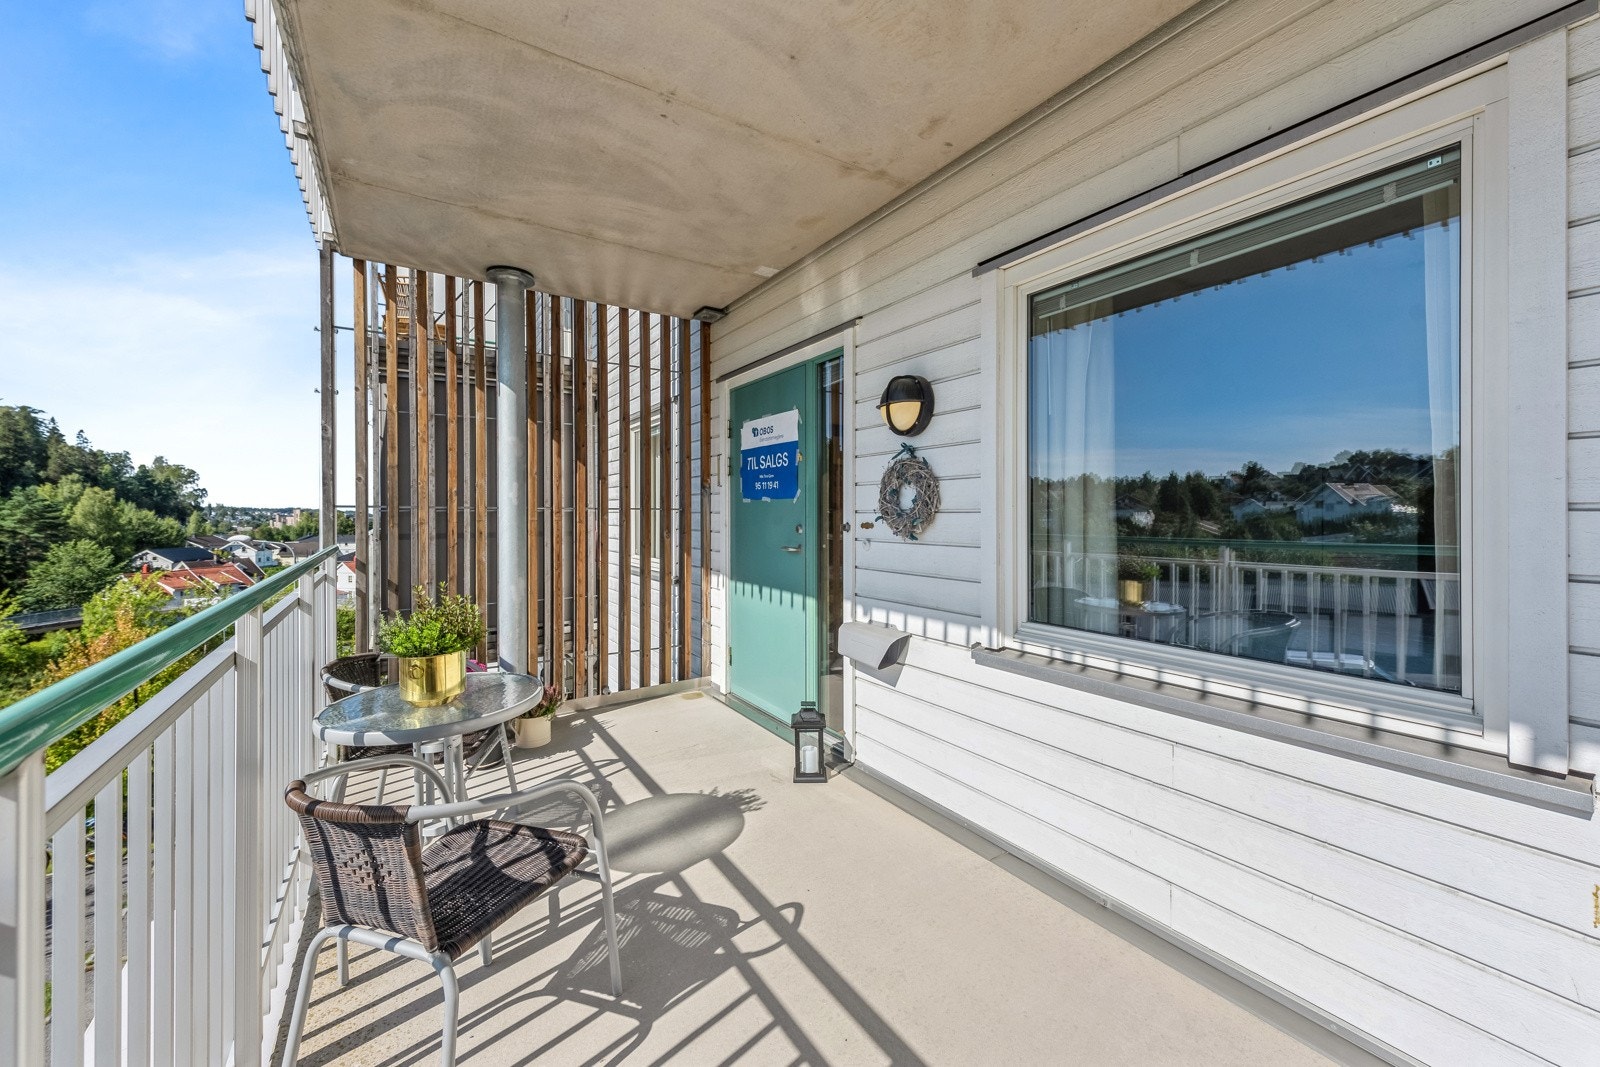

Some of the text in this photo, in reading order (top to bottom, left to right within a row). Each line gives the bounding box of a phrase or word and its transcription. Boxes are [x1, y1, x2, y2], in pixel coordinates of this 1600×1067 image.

[760, 425, 774, 436] OBOS
[747, 452, 789, 471] TIL SALGS
